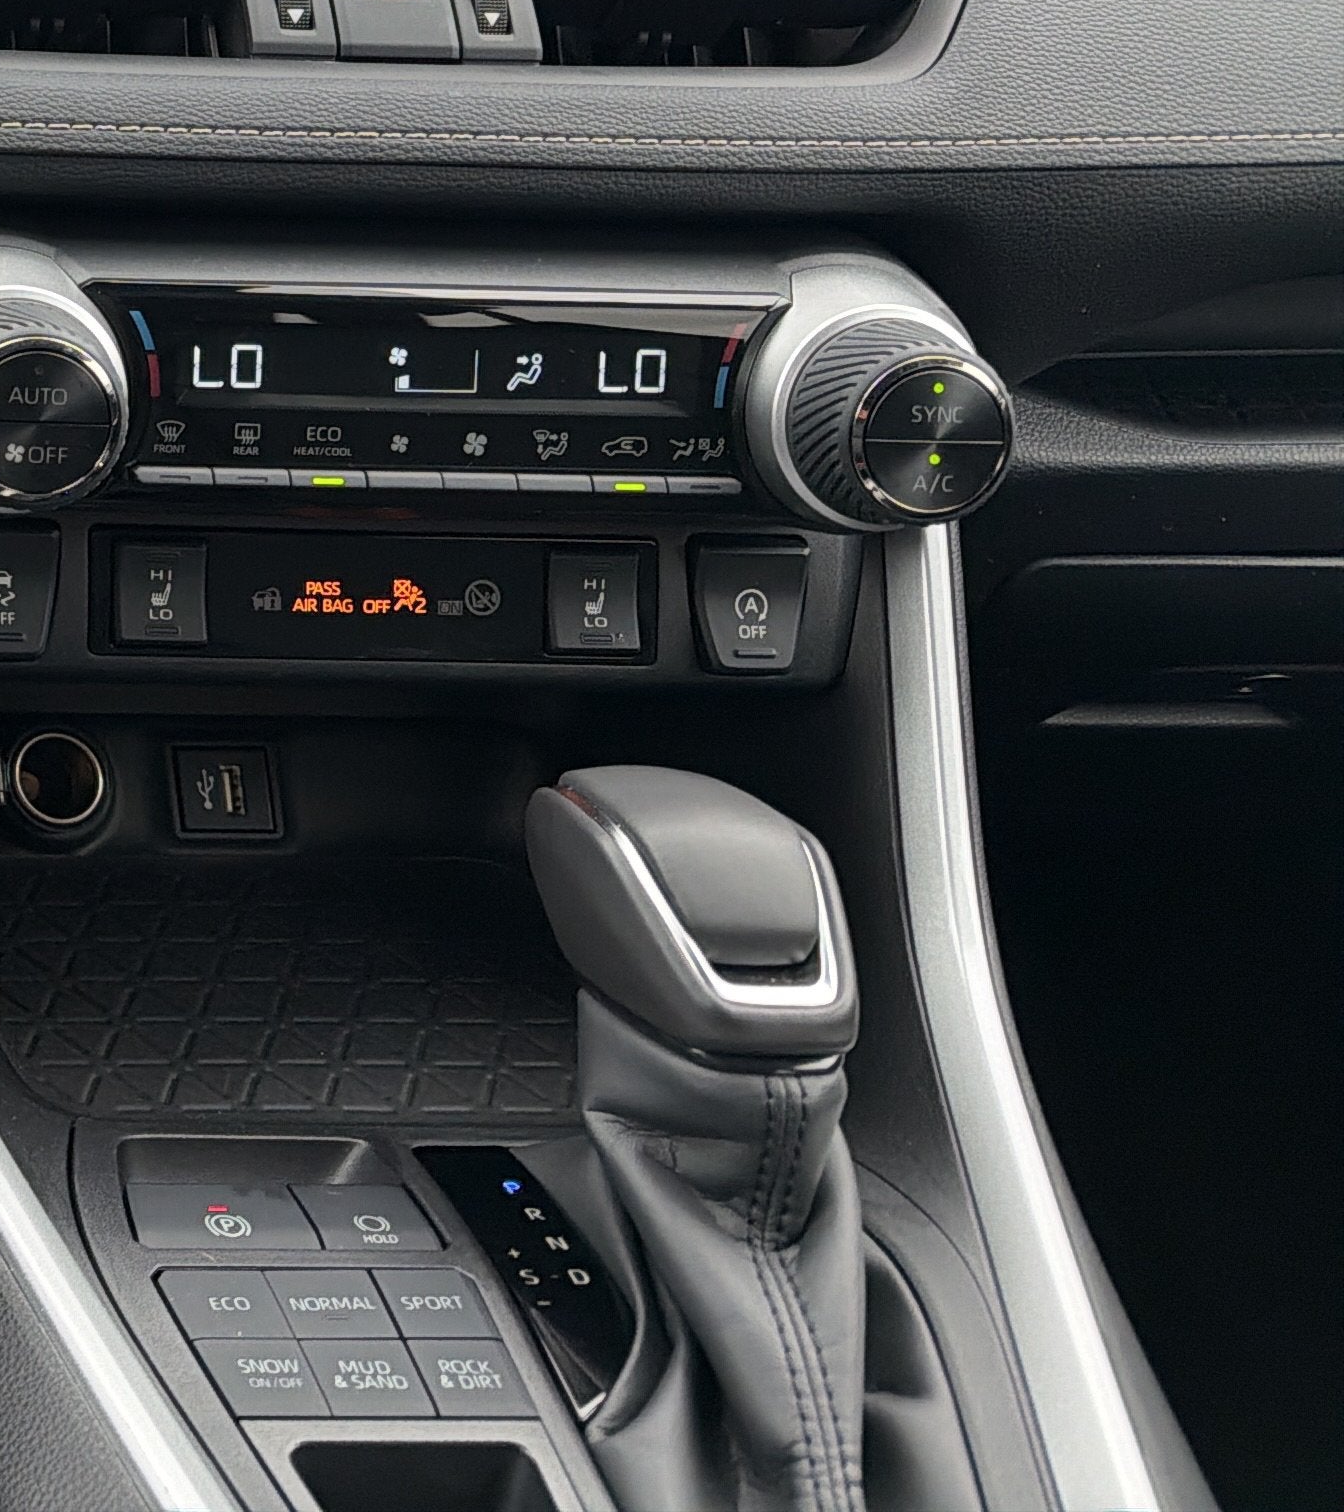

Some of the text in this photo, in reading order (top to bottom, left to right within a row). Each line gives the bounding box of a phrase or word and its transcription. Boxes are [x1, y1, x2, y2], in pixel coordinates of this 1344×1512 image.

[193, 343, 263, 389] LO
[598, 349, 667, 393] LO
[7, 387, 68, 407] AUTO
[911, 405, 964, 425] SYNC
[306, 426, 342, 443] ECO
[27, 446, 68, 465] OFF
[153, 443, 187, 455] FRONT
[232, 445, 260, 457] REAR
[293, 446, 353, 458] HEAT/COOL
[912, 474, 954, 494] A/C
[149, 569, 174, 581] HI
[305, 581, 341, 596] PASS
[583, 578, 607, 590] HI
[148, 608, 174, 621] LO
[292, 598, 392, 615] AIR BAG OFF
[583, 616, 608, 628] LO
[738, 625, 768, 640] OFF
[523, 1207, 547, 1221] R
[362, 1234, 399, 1245] HOLD
[544, 1235, 570, 1251] N
[518, 1268, 541, 1286] S
[567, 1268, 591, 1286] D
[207, 1296, 251, 1312] ECO
[288, 1297, 378, 1312] NORMAL
[399, 1296, 463, 1312] SPORT
[236, 1359, 300, 1374] SNOW
[338, 1359, 392, 1375] MUD
[437, 1359, 493, 1375] ROCK
[248, 1377, 304, 1388] ON/OFF
[333, 1374, 409, 1390] & SAND
[439, 1374, 503, 1389] & DIRT
